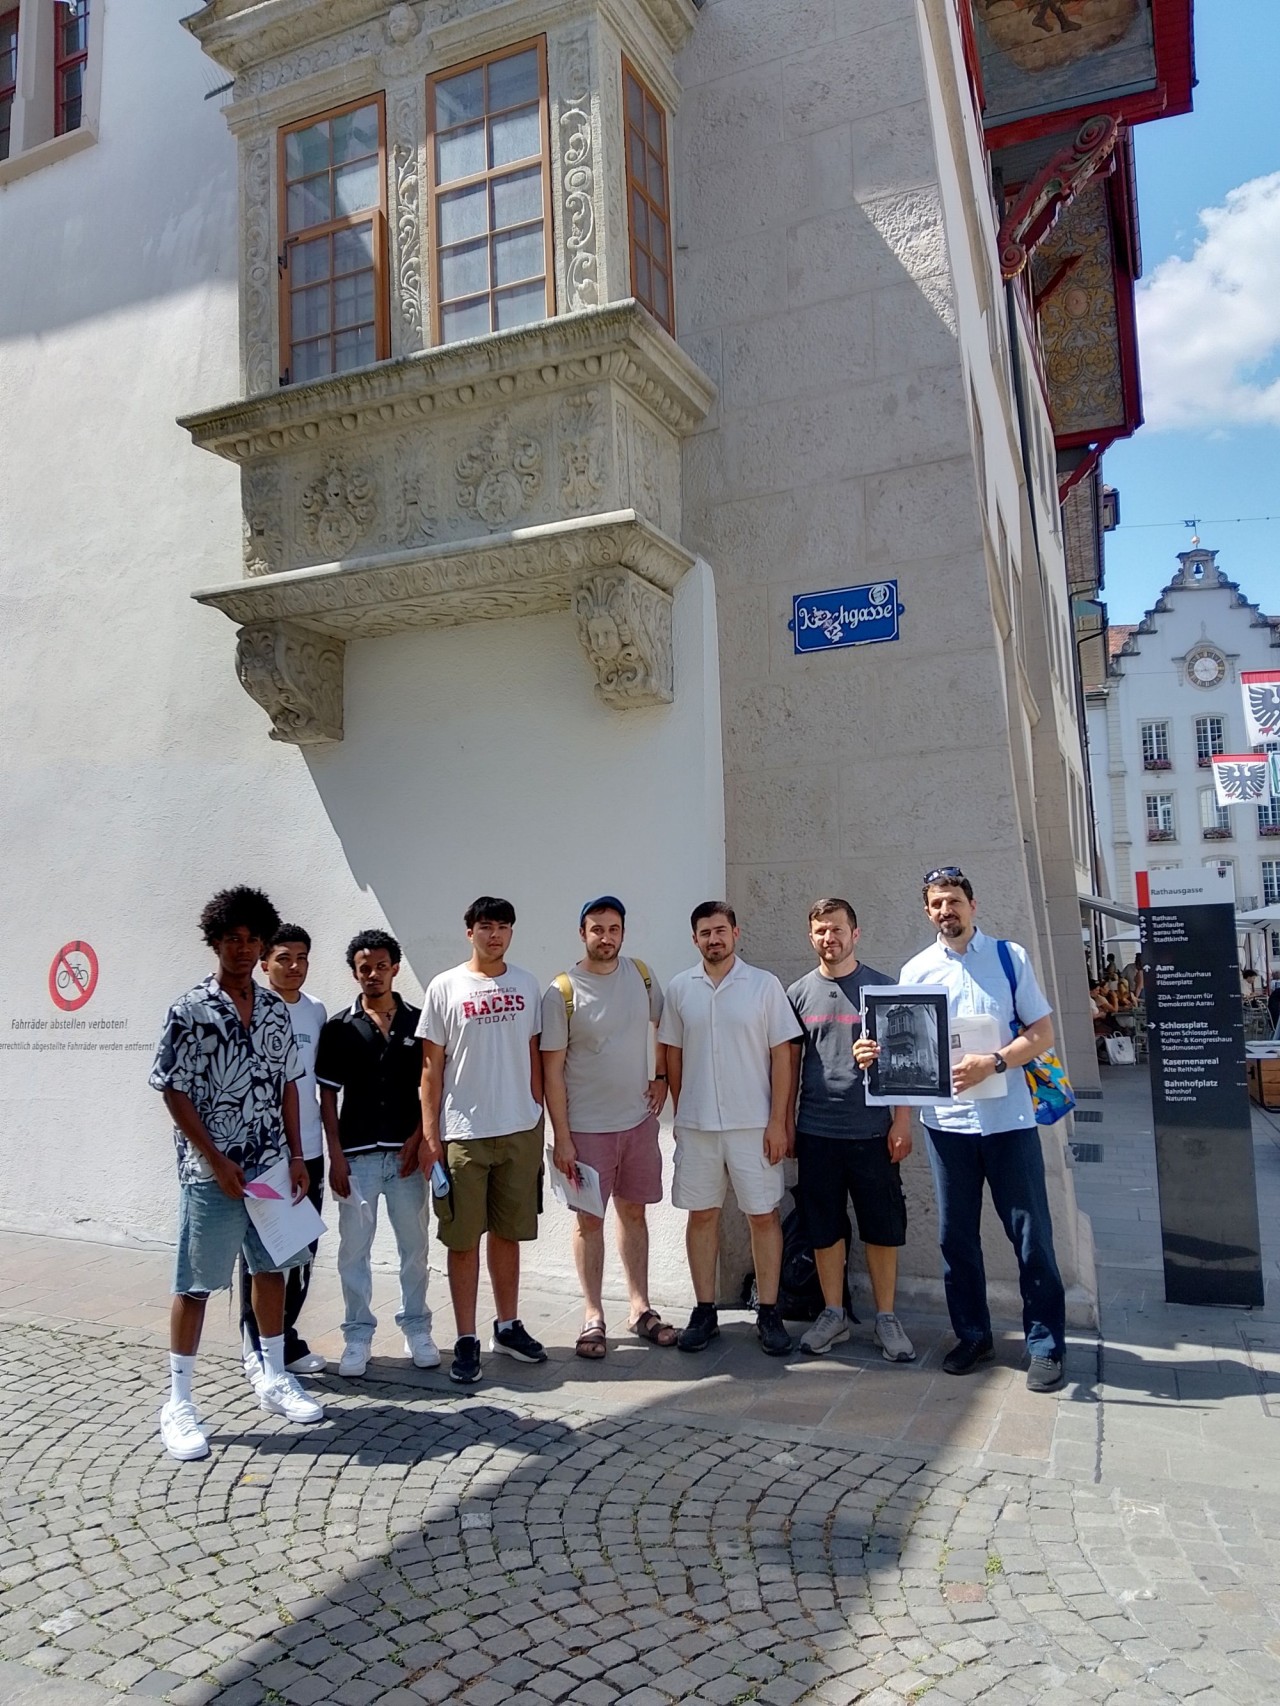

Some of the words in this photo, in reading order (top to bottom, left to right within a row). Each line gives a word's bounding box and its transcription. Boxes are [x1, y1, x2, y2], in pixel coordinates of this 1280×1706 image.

[1151, 887, 1203, 896] Rathausgasse
[1156, 971, 1211, 979] Jugendkulturhaus
[463, 994, 525, 1018] RACES
[476, 1013, 516, 1025] TODAY
[11, 1019, 48, 1030] Fahrräder
[50, 1019, 86, 1029] abstellen
[88, 1019, 128, 1029] verboten!
[1160, 1021, 1208, 1030] Schlossplatz
[1190, 1036, 1232, 1044] Kongresshaus
[32, 1042, 66, 1052] abgestellte
[67, 1042, 97, 1050] Fahrräder
[99, 1042, 123, 1050] werden
[125, 1042, 155, 1050] entfernt!
[1164, 1080, 1218, 1088] Bahnhofplatz
